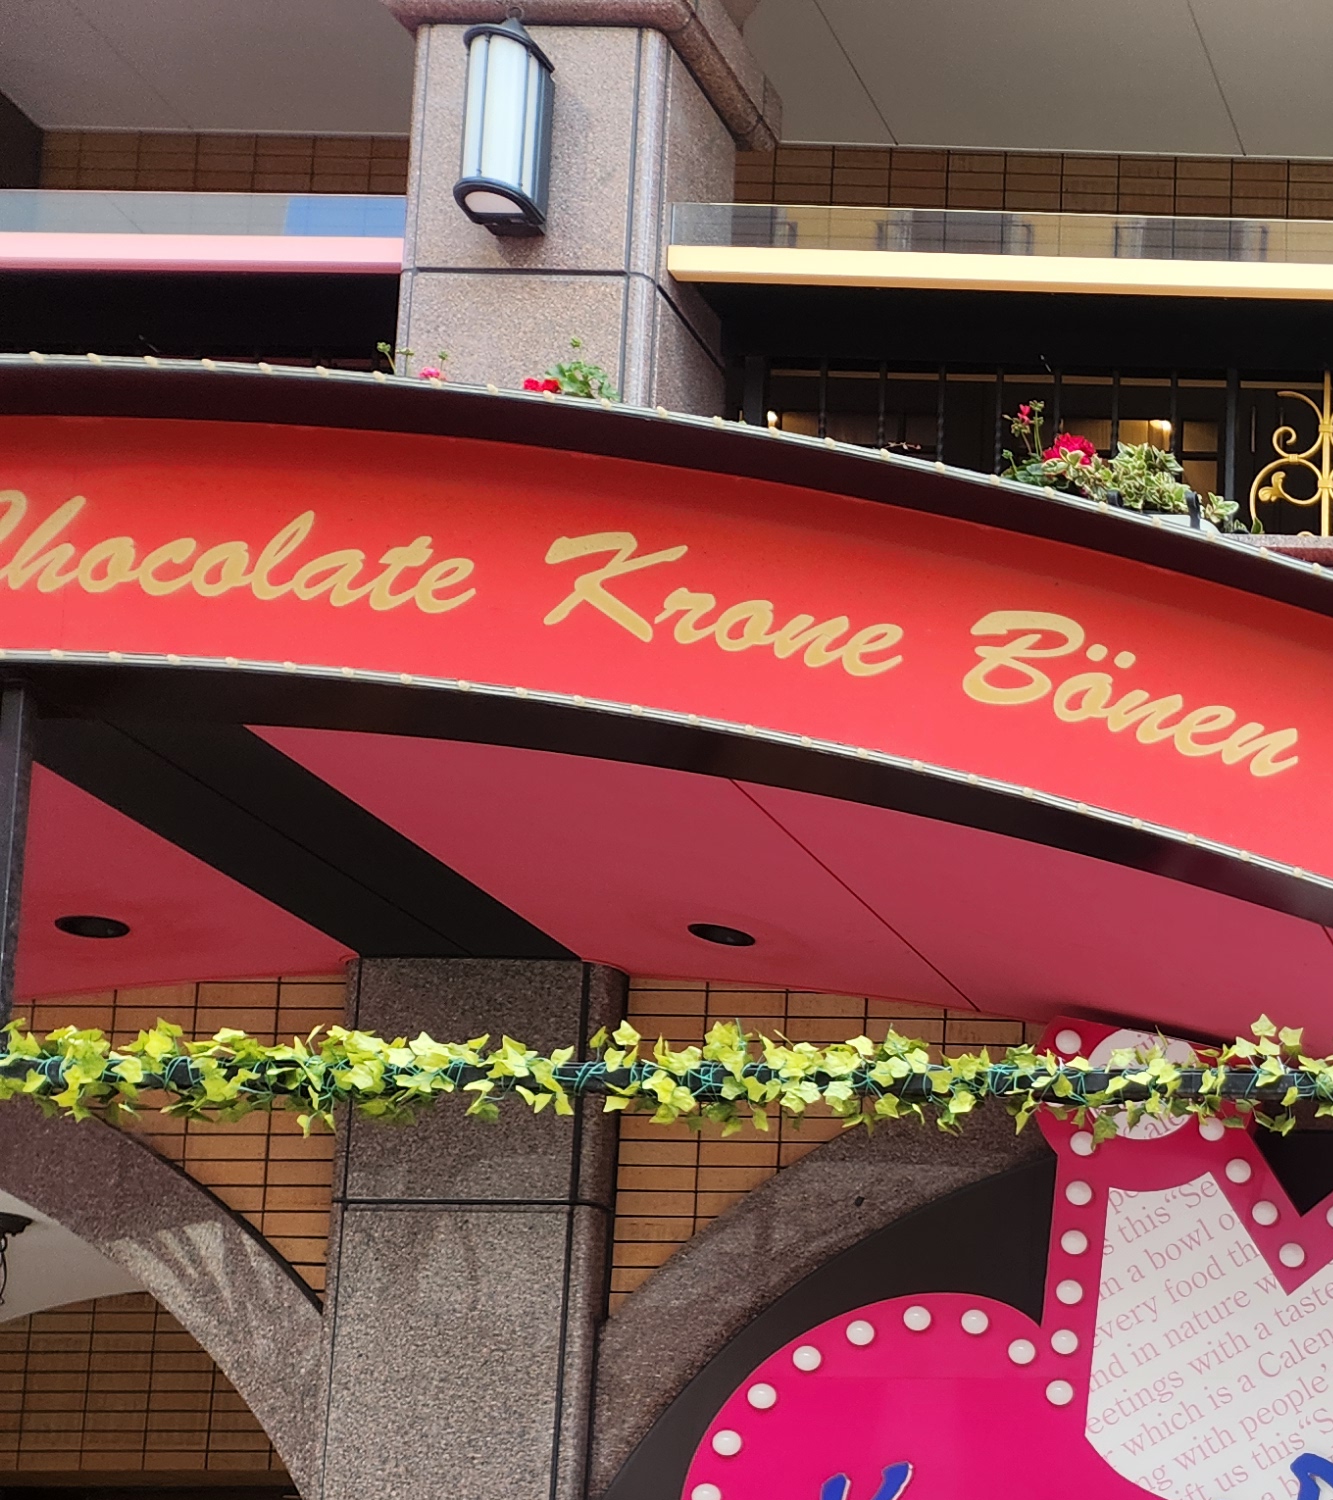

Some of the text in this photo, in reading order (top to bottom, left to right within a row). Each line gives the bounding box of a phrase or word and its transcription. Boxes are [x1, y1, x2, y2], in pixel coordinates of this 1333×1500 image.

[543, 531, 904, 677] Krone
[962, 610, 1299, 779] Bönen
[1117, 1205, 1171, 1245] this
[1126, 1264, 1146, 1284] a
[1143, 1217, 1215, 1271] bowl
[1163, 1254, 1226, 1305] food
[1126, 1342, 1162, 1368] in
[1162, 1288, 1252, 1351] nature
[1187, 1330, 1252, 1377] with
[1254, 1322, 1273, 1341] a
[1120, 1400, 1205, 1457] which
[1203, 1385, 1234, 1411] is
[1236, 1373, 1256, 1393] a
[1173, 1424, 1237, 1472] with
[1214, 1463, 1250, 1493] us
[1250, 1430, 1306, 1472] this
